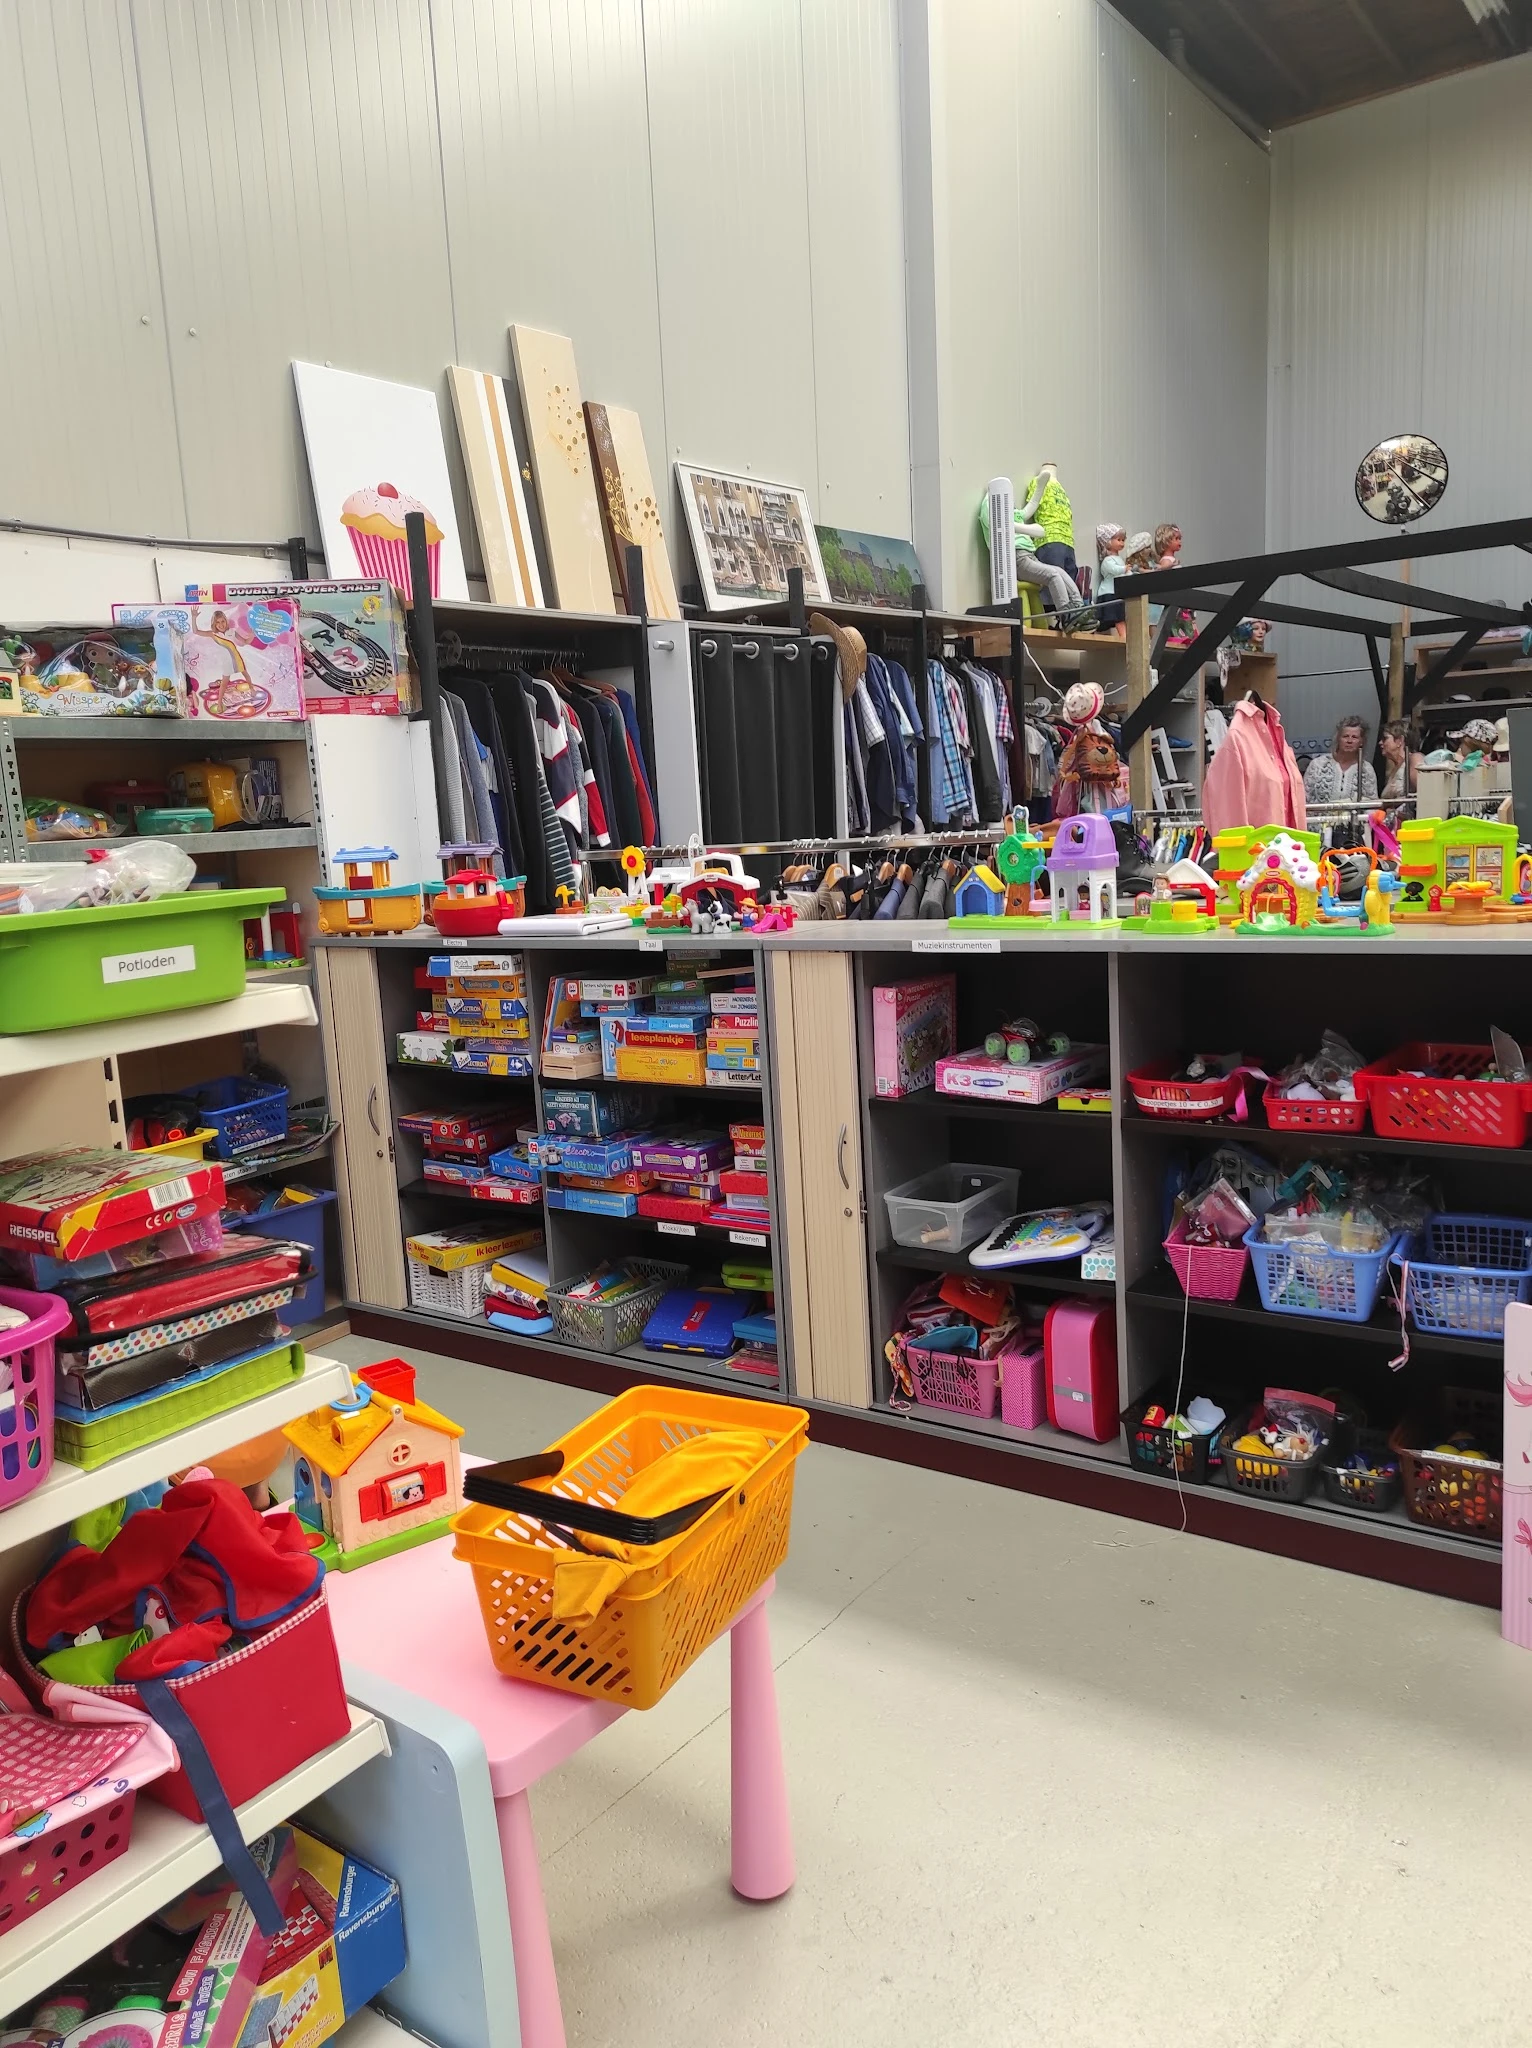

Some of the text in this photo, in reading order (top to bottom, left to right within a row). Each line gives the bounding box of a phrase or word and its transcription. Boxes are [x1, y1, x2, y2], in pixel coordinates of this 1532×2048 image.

[228, 583, 381, 597] DOUBLE FLY-OVER CHASE
[918, 941, 993, 950] Muziekinstrumenten
[118, 954, 176, 974] Potloden
[631, 1032, 685, 1045] leesplankje
[946, 1072, 972, 1087] K3
[9, 1224, 58, 1244] REISSPEL
[734, 1233, 760, 1243] Rekenen
[476, 1238, 525, 1257] Ik leer lezen
[339, 1865, 357, 1919] Ravensburger
[338, 1895, 393, 1943] Ravensburger
[176, 1913, 226, 1996] OWN FASHION
